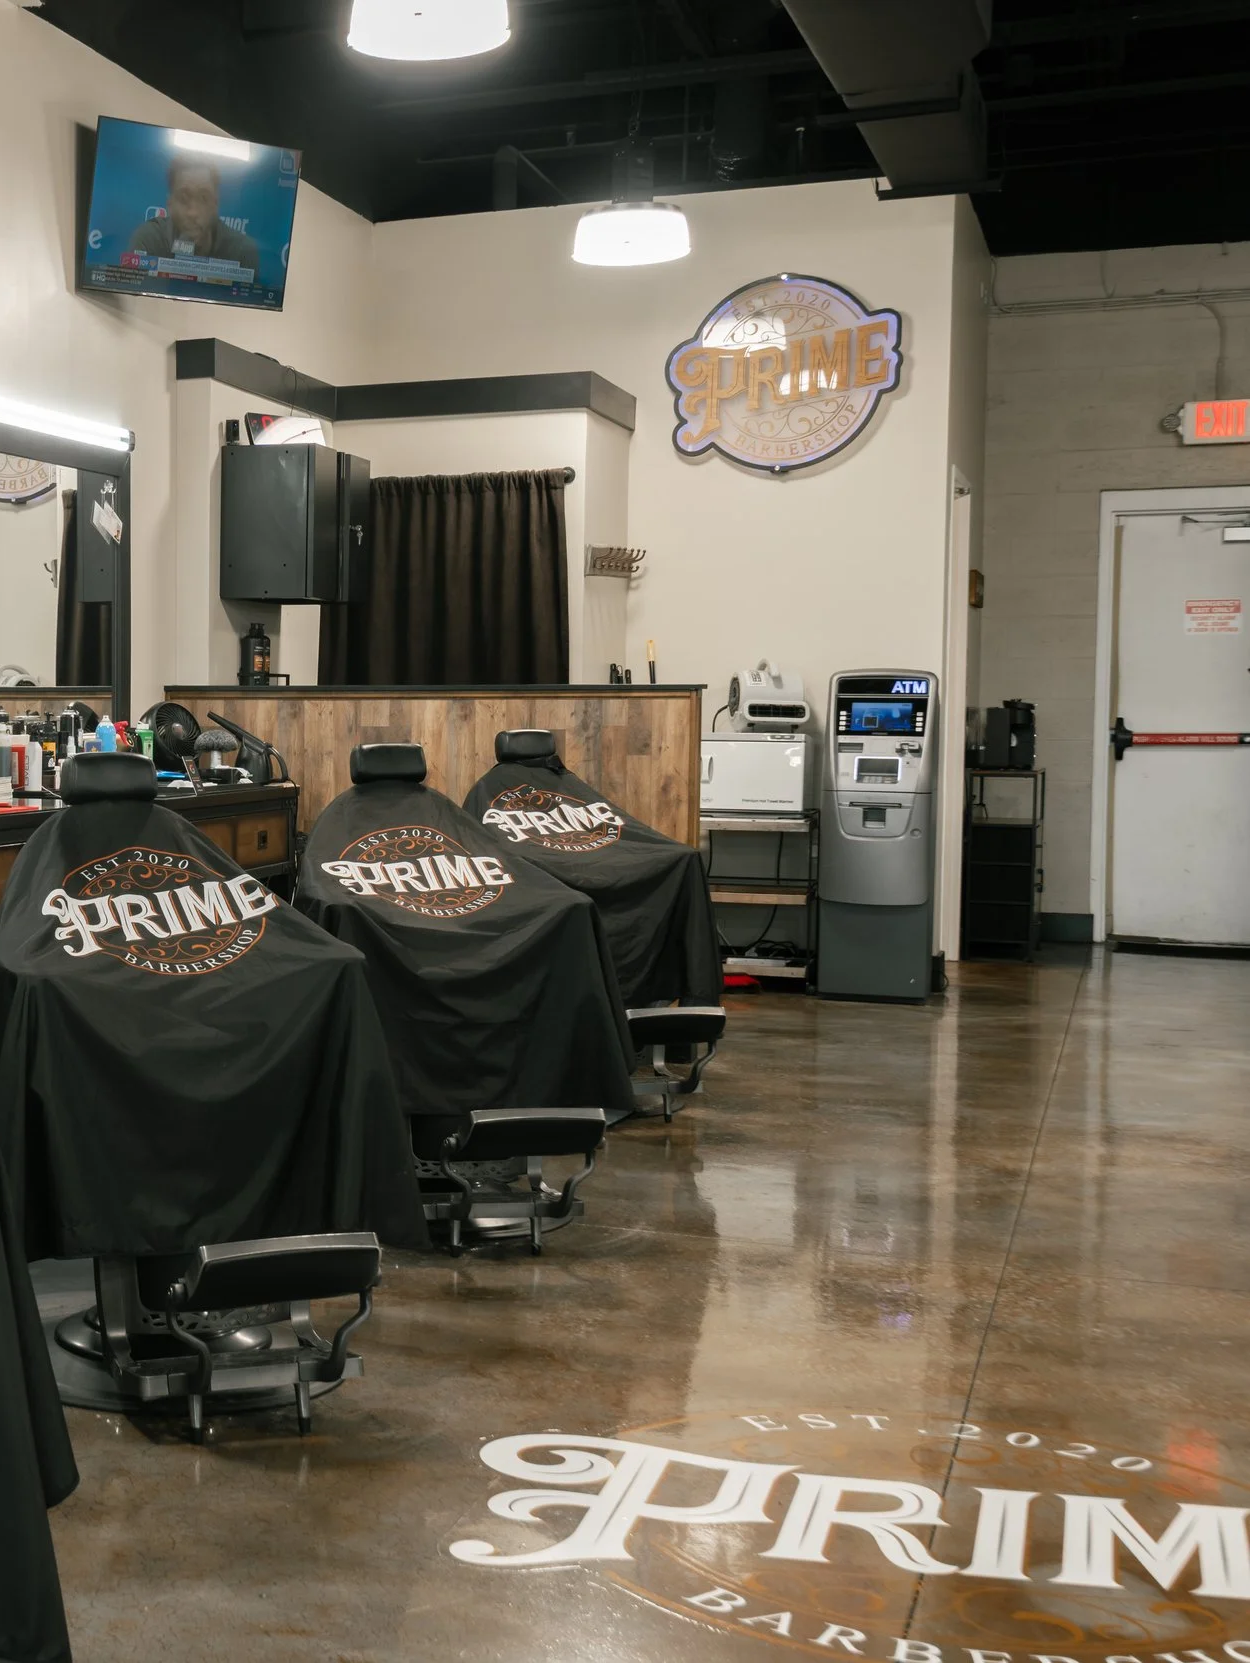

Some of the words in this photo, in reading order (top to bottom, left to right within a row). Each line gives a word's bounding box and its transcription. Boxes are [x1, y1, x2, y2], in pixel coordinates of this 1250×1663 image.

[675, 320, 890, 444] PRIME
[734, 403, 860, 456] BARBERSHOP
[1195, 401, 1248, 437] EXIT
[891, 681, 927, 694] ATM
[482, 802, 624, 842] PRIME
[321, 855, 514, 896] PRIME
[42, 873, 279, 957] PRIME
[124, 929, 259, 974] BARBERSHOP
